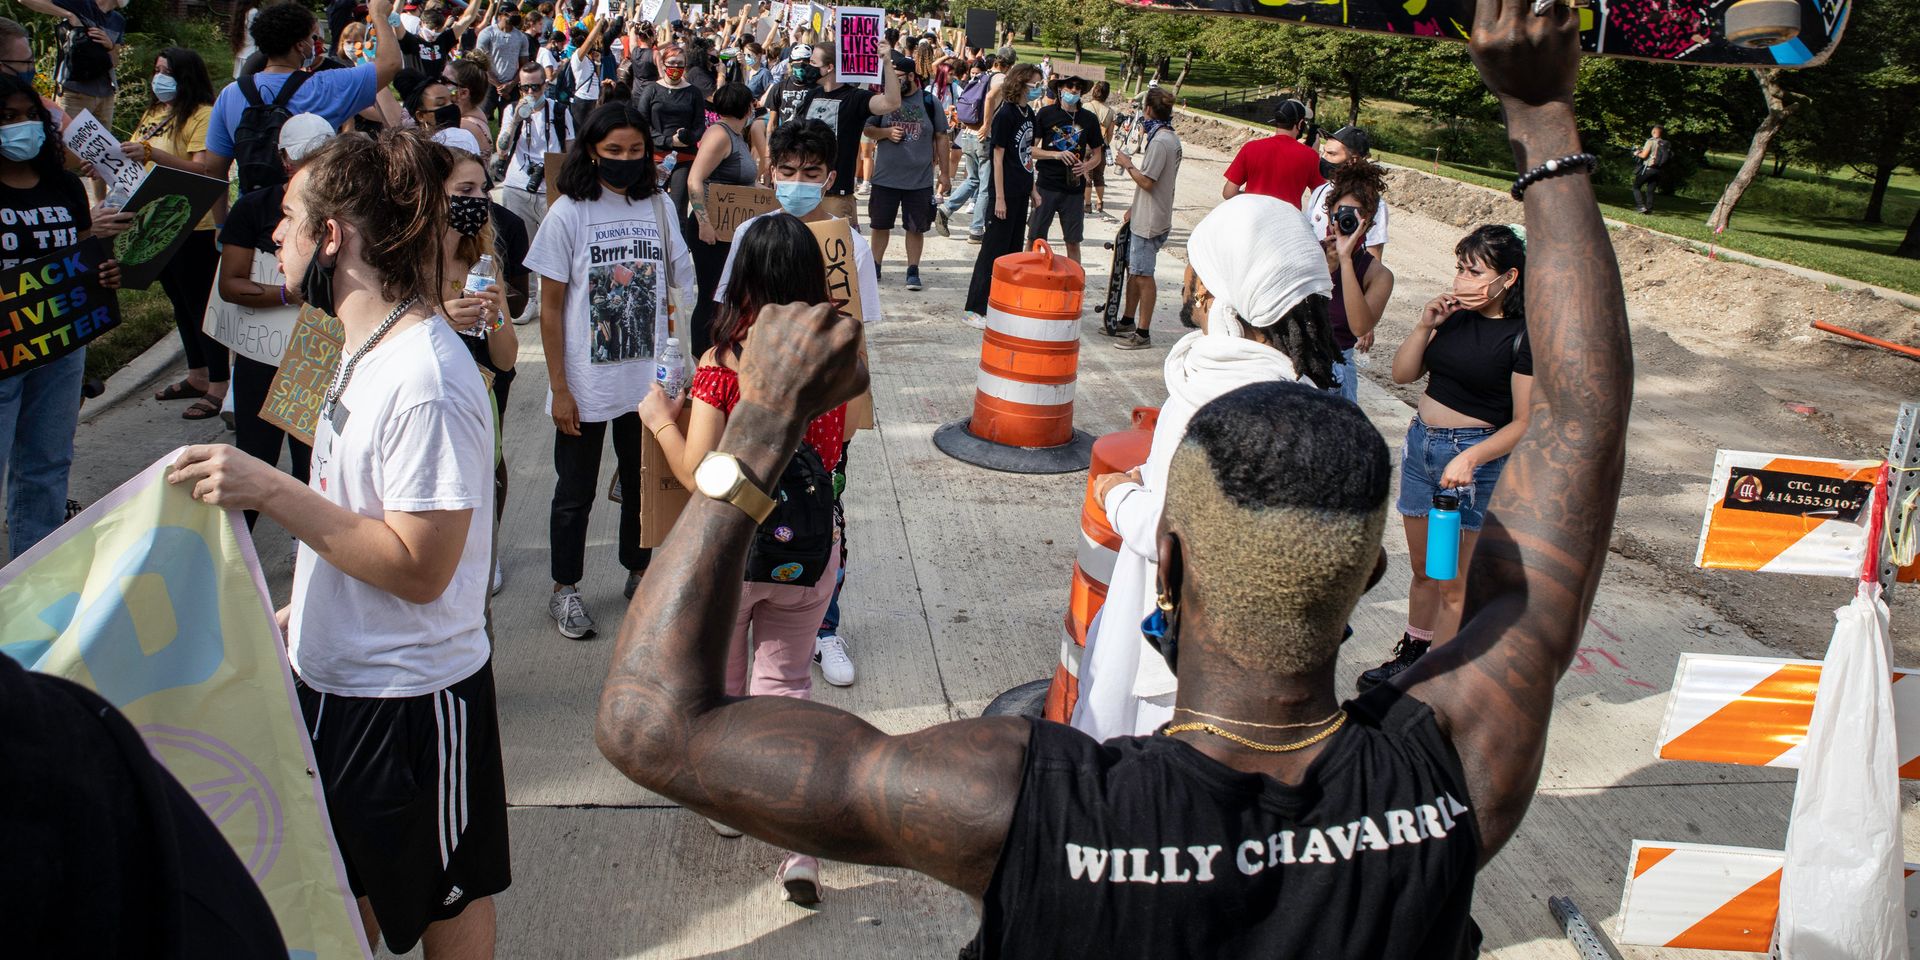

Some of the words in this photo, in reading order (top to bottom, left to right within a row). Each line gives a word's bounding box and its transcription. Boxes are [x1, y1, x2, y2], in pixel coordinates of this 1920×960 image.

[841, 16, 879, 36] BLACK
[841, 36, 879, 54] LIVES
[841, 54, 878, 73] MATTER
[81, 134, 112, 164] RACISM
[100, 153, 123, 175] IS
[716, 191, 735, 203] WE
[33, 227, 77, 249] THE
[595, 228, 631, 241] JOURNAL
[1818, 484, 1840, 494] LLC
[1066, 843, 1222, 884] WILLY
